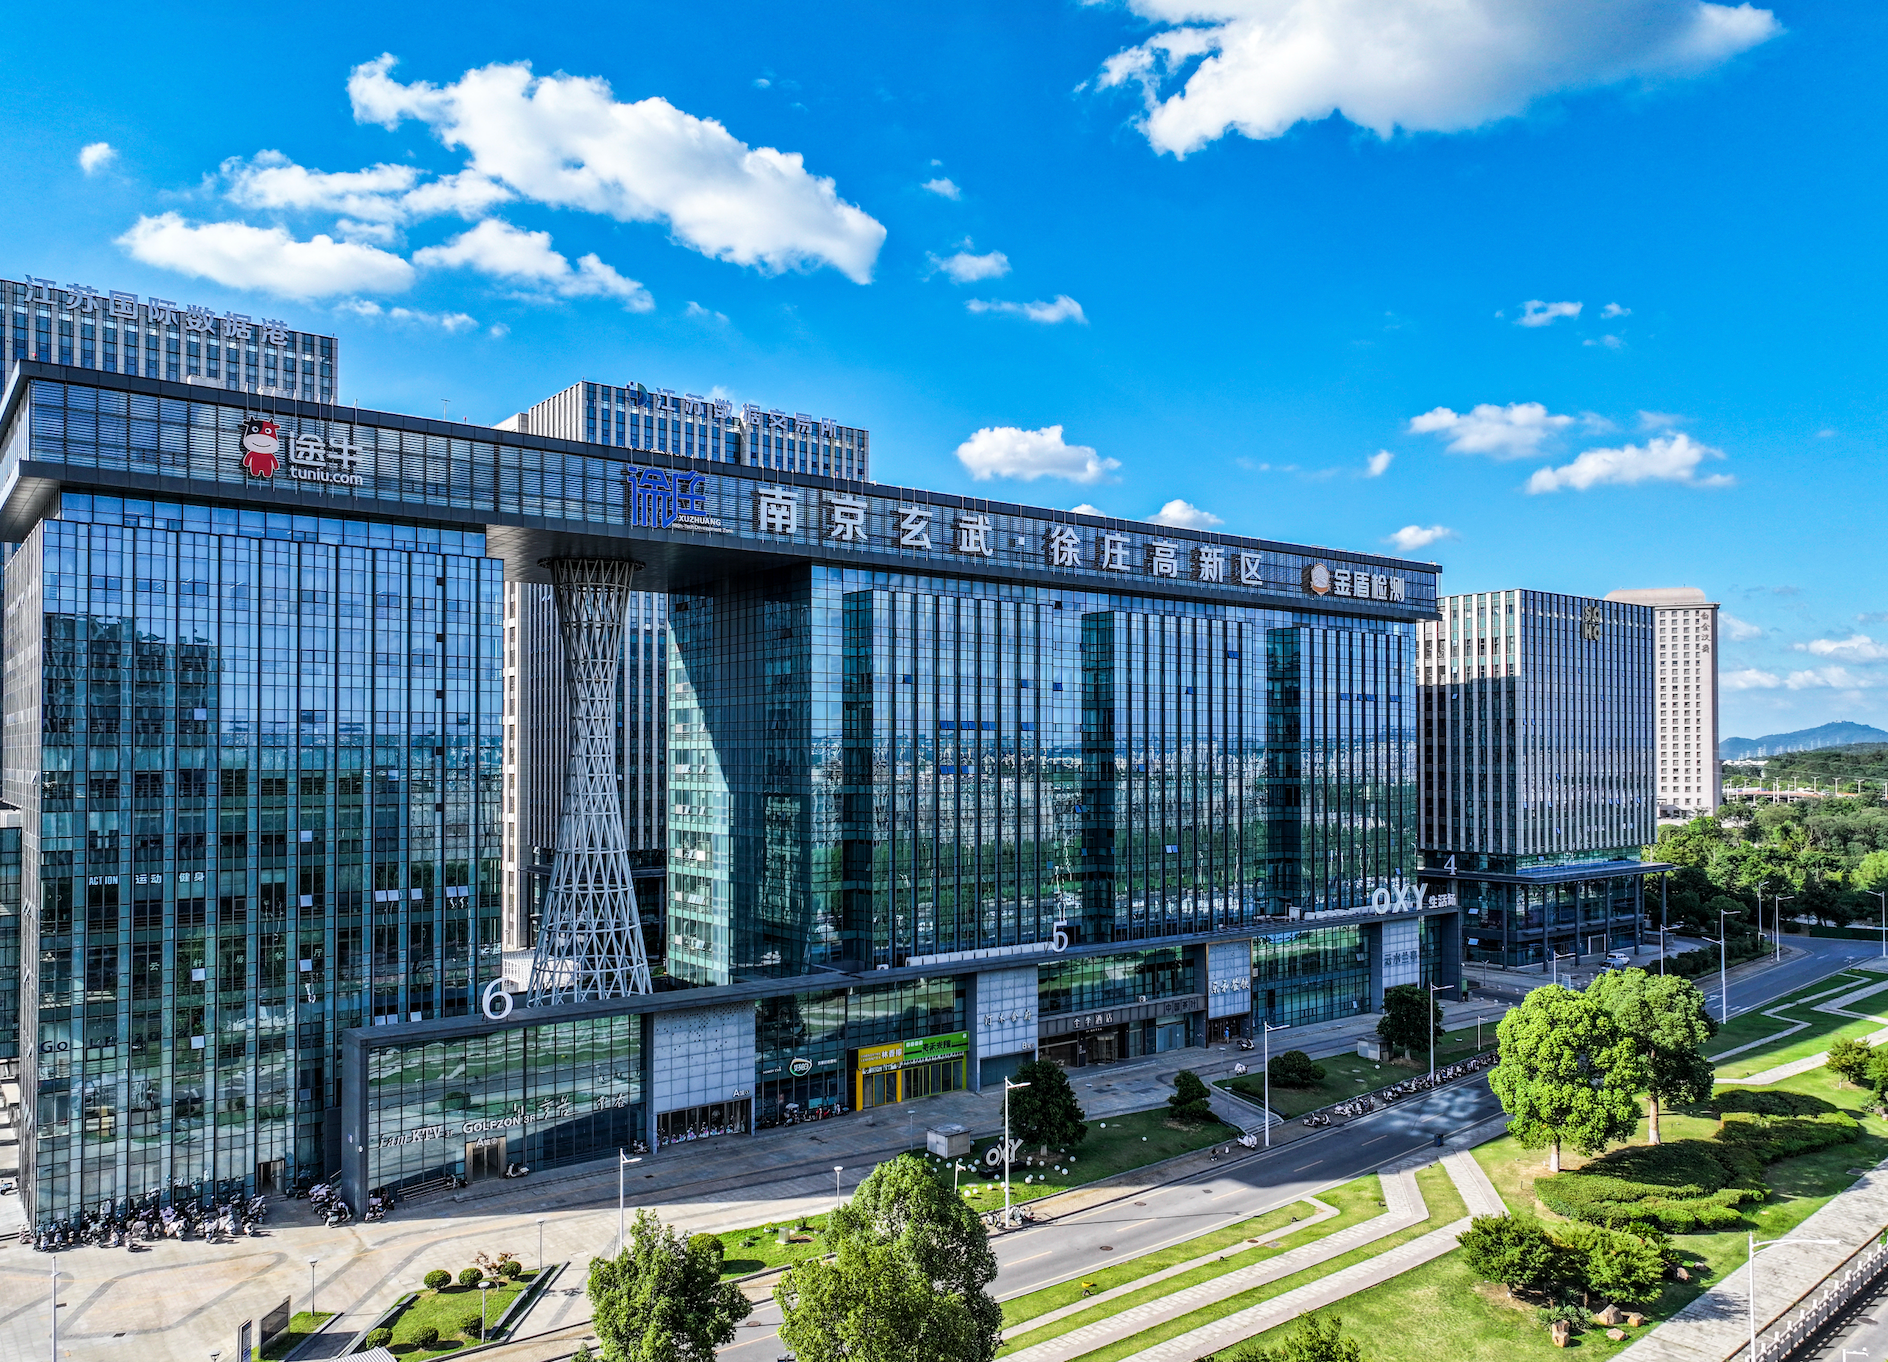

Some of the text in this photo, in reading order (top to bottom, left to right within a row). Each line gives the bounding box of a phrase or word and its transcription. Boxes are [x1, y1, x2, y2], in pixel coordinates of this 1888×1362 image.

[24, 274, 289, 346] 江苏国际数据港
[655, 387, 838, 438] 江苏数据交易所
[288, 430, 363, 470] 途牛
[290, 466, 363, 486] tuniu.com
[678, 514, 721, 526] XUZHUANG
[1334, 568, 1405, 602] 金盾检测
[89, 875, 118, 886] ACTION
[1443, 854, 1457, 876] 4
[1372, 883, 1428, 915] OXY
[1052, 920, 1069, 953] 5
[482, 977, 514, 1020] 6
[410, 1125, 444, 1143] KTV
[462, 1114, 537, 1134] GOLFZON 3F
